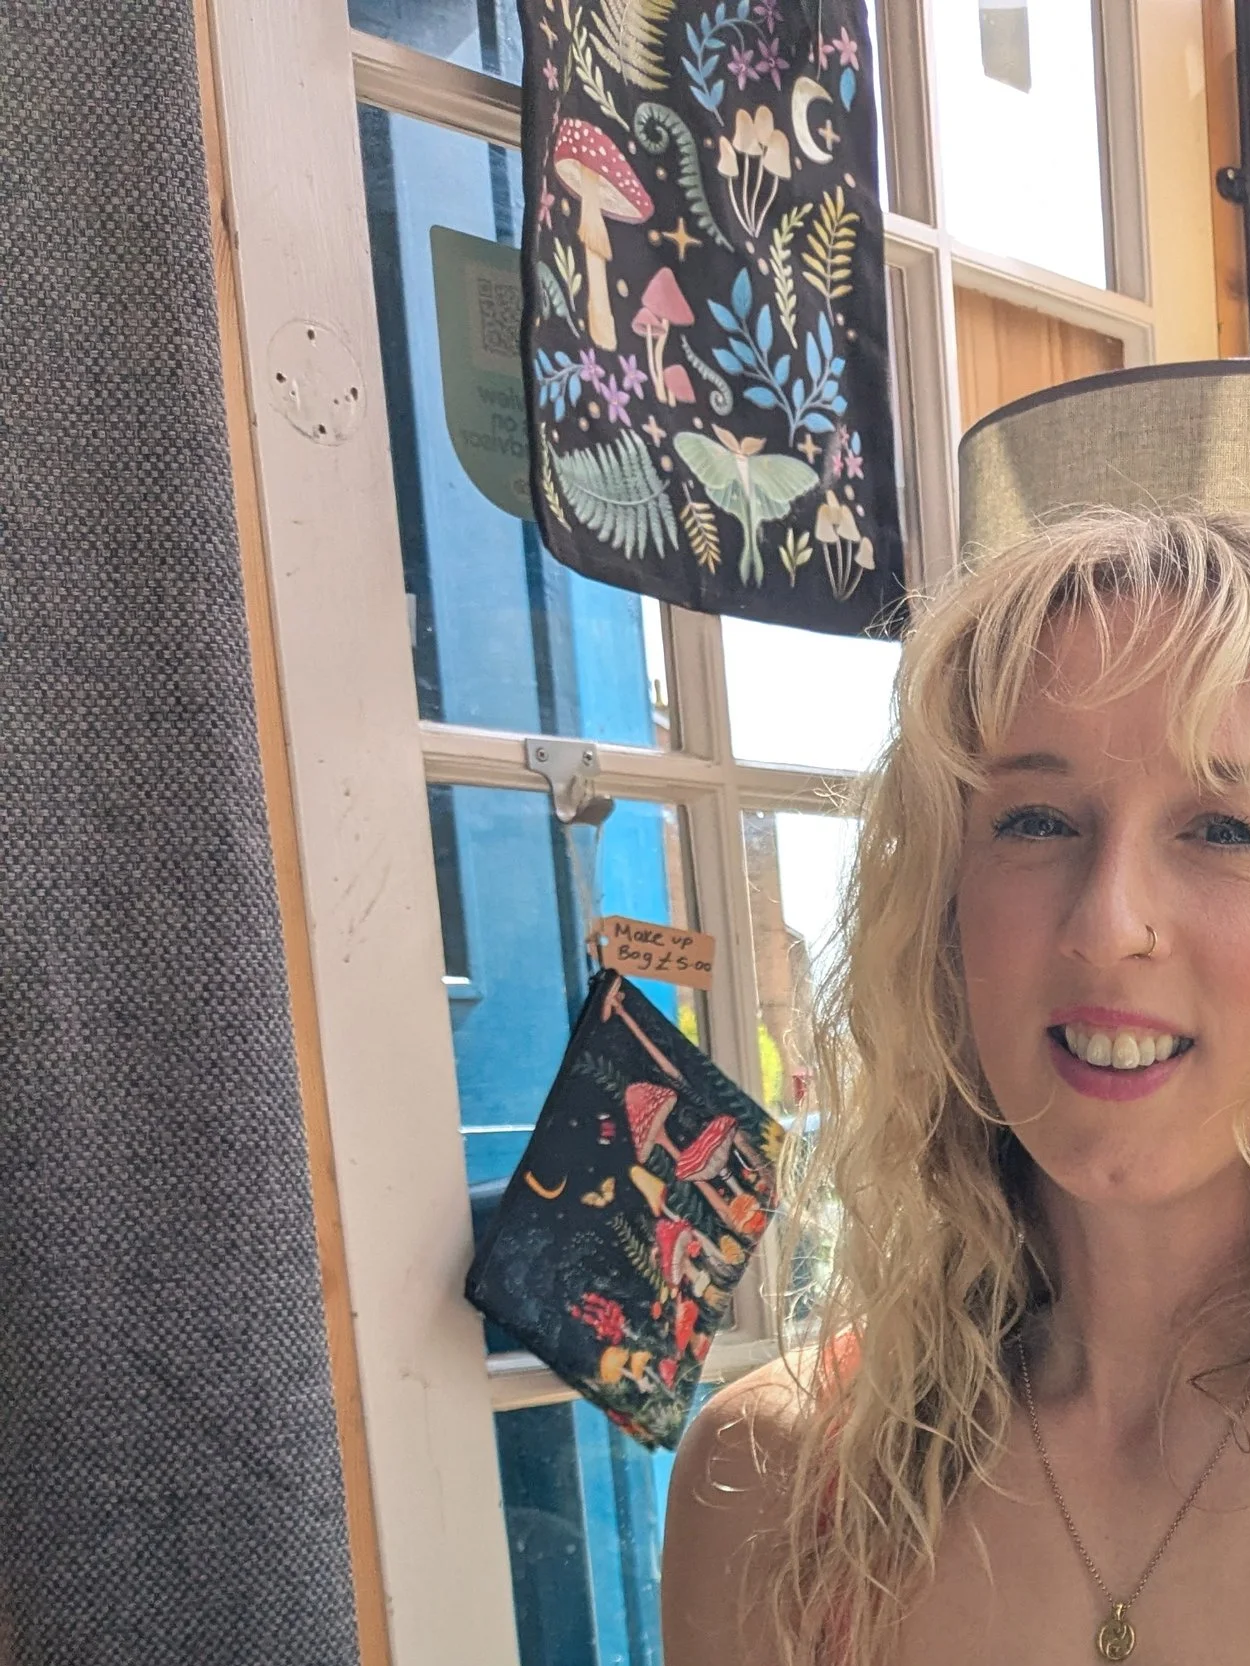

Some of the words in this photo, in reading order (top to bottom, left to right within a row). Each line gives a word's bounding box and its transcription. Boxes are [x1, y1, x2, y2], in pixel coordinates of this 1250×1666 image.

[615, 923, 665, 946] Make
[672, 936, 693, 950] up
[618, 944, 652, 970] Bag
